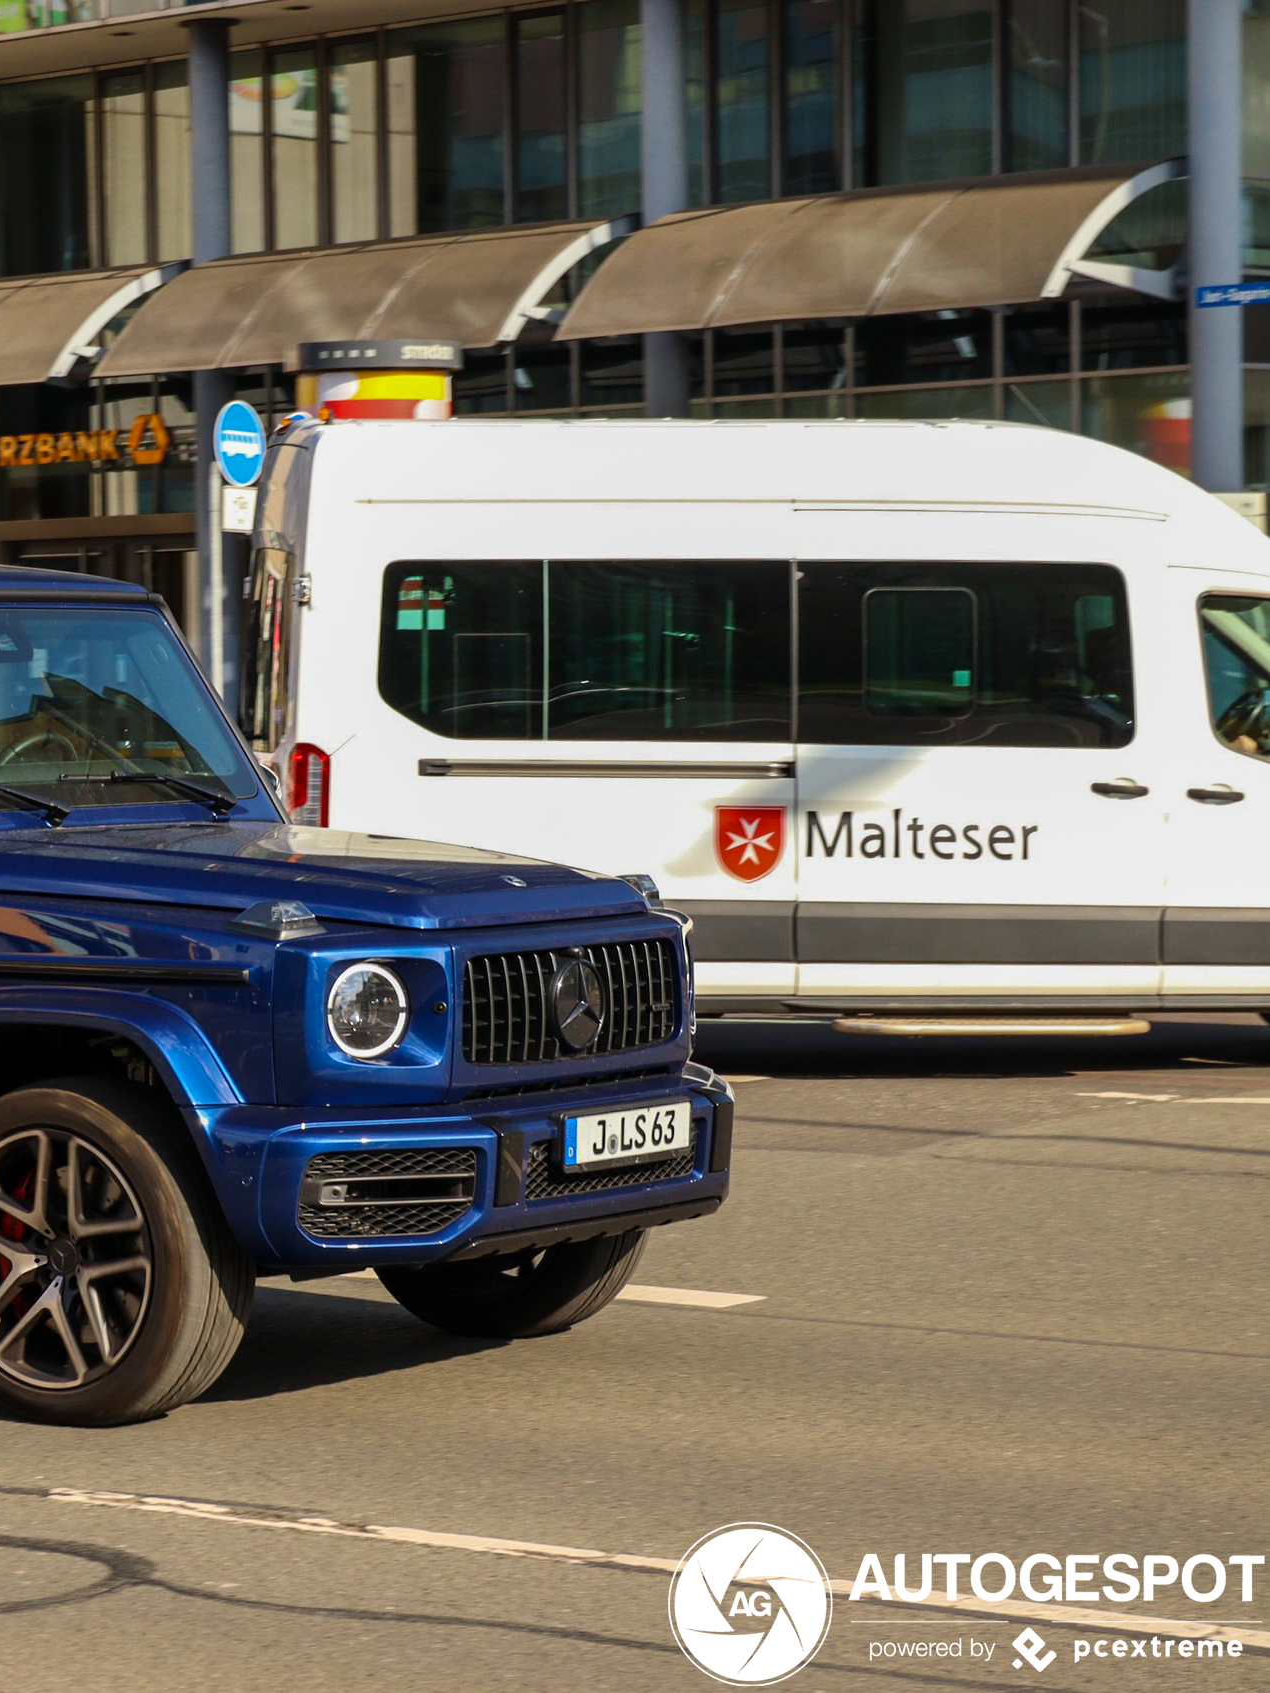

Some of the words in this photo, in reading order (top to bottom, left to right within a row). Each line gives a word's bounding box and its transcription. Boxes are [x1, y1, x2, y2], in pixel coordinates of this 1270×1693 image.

[805, 808, 1038, 861] Malteser
[568, 1146, 574, 1158] D
[593, 1119, 606, 1155] J
